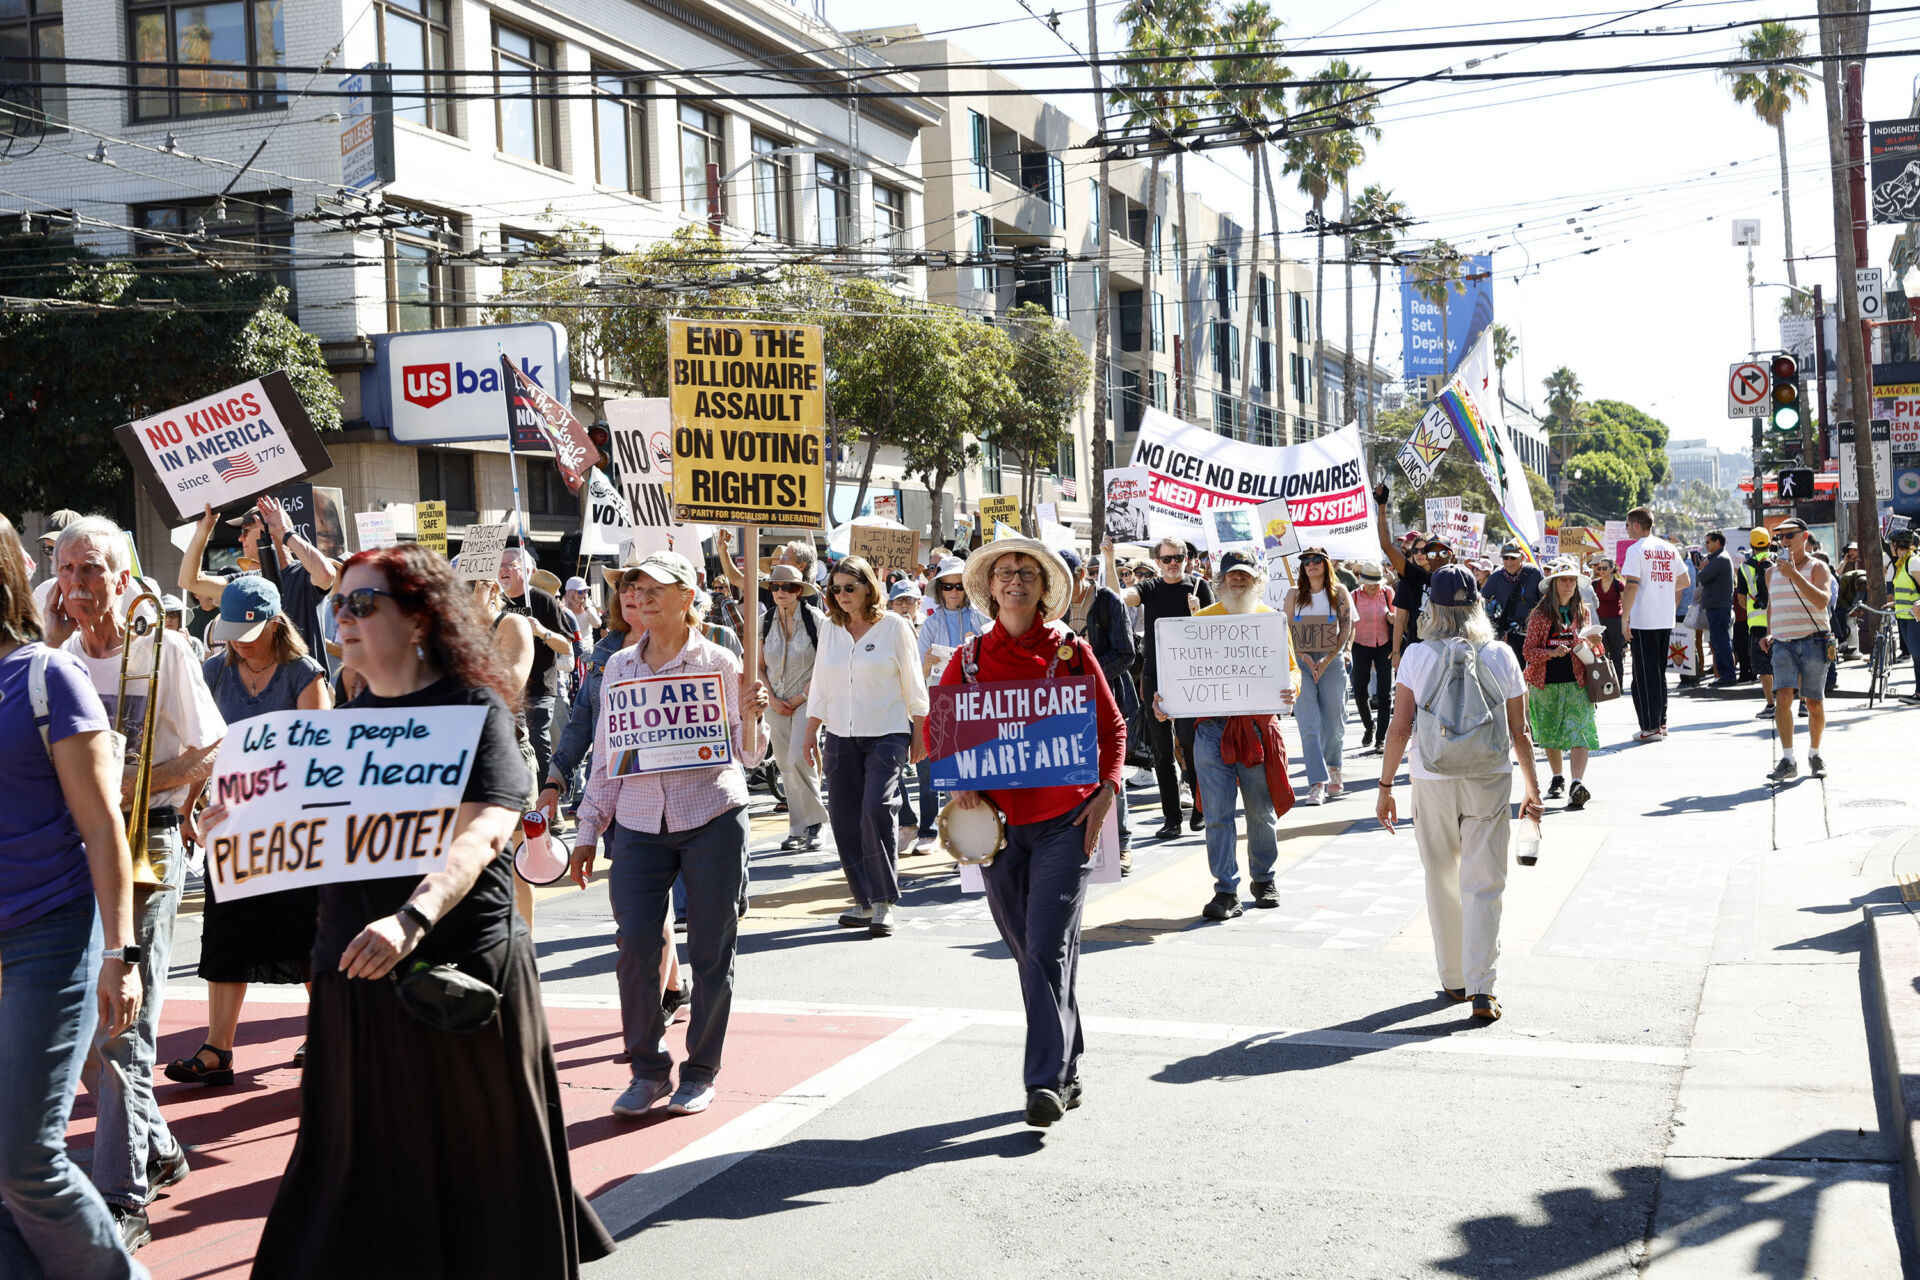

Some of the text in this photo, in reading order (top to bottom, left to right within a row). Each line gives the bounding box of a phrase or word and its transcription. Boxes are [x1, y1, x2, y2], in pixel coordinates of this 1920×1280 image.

[1874, 124, 1919, 135] INDIGENIZE
[1857, 272, 1878, 281] EED
[1857, 284, 1874, 293] MIT
[1863, 296, 1878, 313] 0
[1411, 317, 1436, 332] Set.
[686, 326, 805, 358] END THE
[407, 370, 448, 398] us
[456, 357, 544, 395] bak
[674, 359, 818, 391] BILLIONAIRE
[694, 391, 803, 421] ASSAULT
[1732, 405, 1766, 416] ON RED
[144, 392, 262, 451] NO KINGS
[1429, 410, 1453, 440] NO
[1841, 426, 1888, 437] RIG ANE
[1891, 432, 1919, 443] OOD
[158, 418, 275, 472] IN AMERICA
[614, 429, 650, 475] NO
[675, 428, 819, 465] ON VOTING
[177, 444, 286, 492] since 1776
[1136, 439, 1361, 498] NO ICE! NO BILLIONAIRES!
[1397, 446, 1427, 489] KINGS
[691, 469, 806, 508] RIGHTS!
[1114, 480, 1138, 489] FUCK
[1107, 490, 1147, 501] FASCISM
[1148, 476, 1157, 497] E
[1155, 479, 1197, 509] NEED
[1288, 503, 1308, 522] EW
[1308, 491, 1366, 522] SYSTEM!
[418, 510, 444, 519] OPERATION
[691, 509, 820, 524] PARTY FOR SOCIALISM & LIBERATION
[983, 504, 1016, 515] OPERATION
[1155, 505, 1190, 521] SOCIALISM
[1454, 513, 1469, 522] NO
[469, 525, 503, 539] PROTECT
[1447, 523, 1472, 533] KINGS
[1560, 528, 1573, 537] NO
[418, 532, 446, 542] CALIFORNIA!
[892, 531, 912, 544] take
[1560, 536, 1587, 547] KINGS
[460, 538, 507, 554] IMMIGRANTS
[860, 544, 873, 555] my
[875, 542, 893, 557] city
[459, 557, 496, 574] FUCK ICE
[888, 555, 907, 569] ICE
[1658, 560, 1671, 571] THE
[1650, 571, 1673, 582] FUTURE
[1184, 624, 1262, 641] SUPPORT
[1291, 623, 1338, 649] NOPE
[1189, 664, 1267, 677] DEMOCRACY
[608, 682, 717, 712] YOU ARE
[955, 684, 1088, 722] HEALTH CARE
[608, 703, 720, 734] BELOVED
[243, 718, 431, 753] We the people
[609, 724, 722, 749] NO EXCEPTIONS!
[998, 721, 1026, 741] NOT
[954, 732, 1087, 780] WARFARE
[304, 758, 344, 787] be
[358, 749, 469, 786] heard
[213, 807, 459, 885] PLEASE VOTE!
